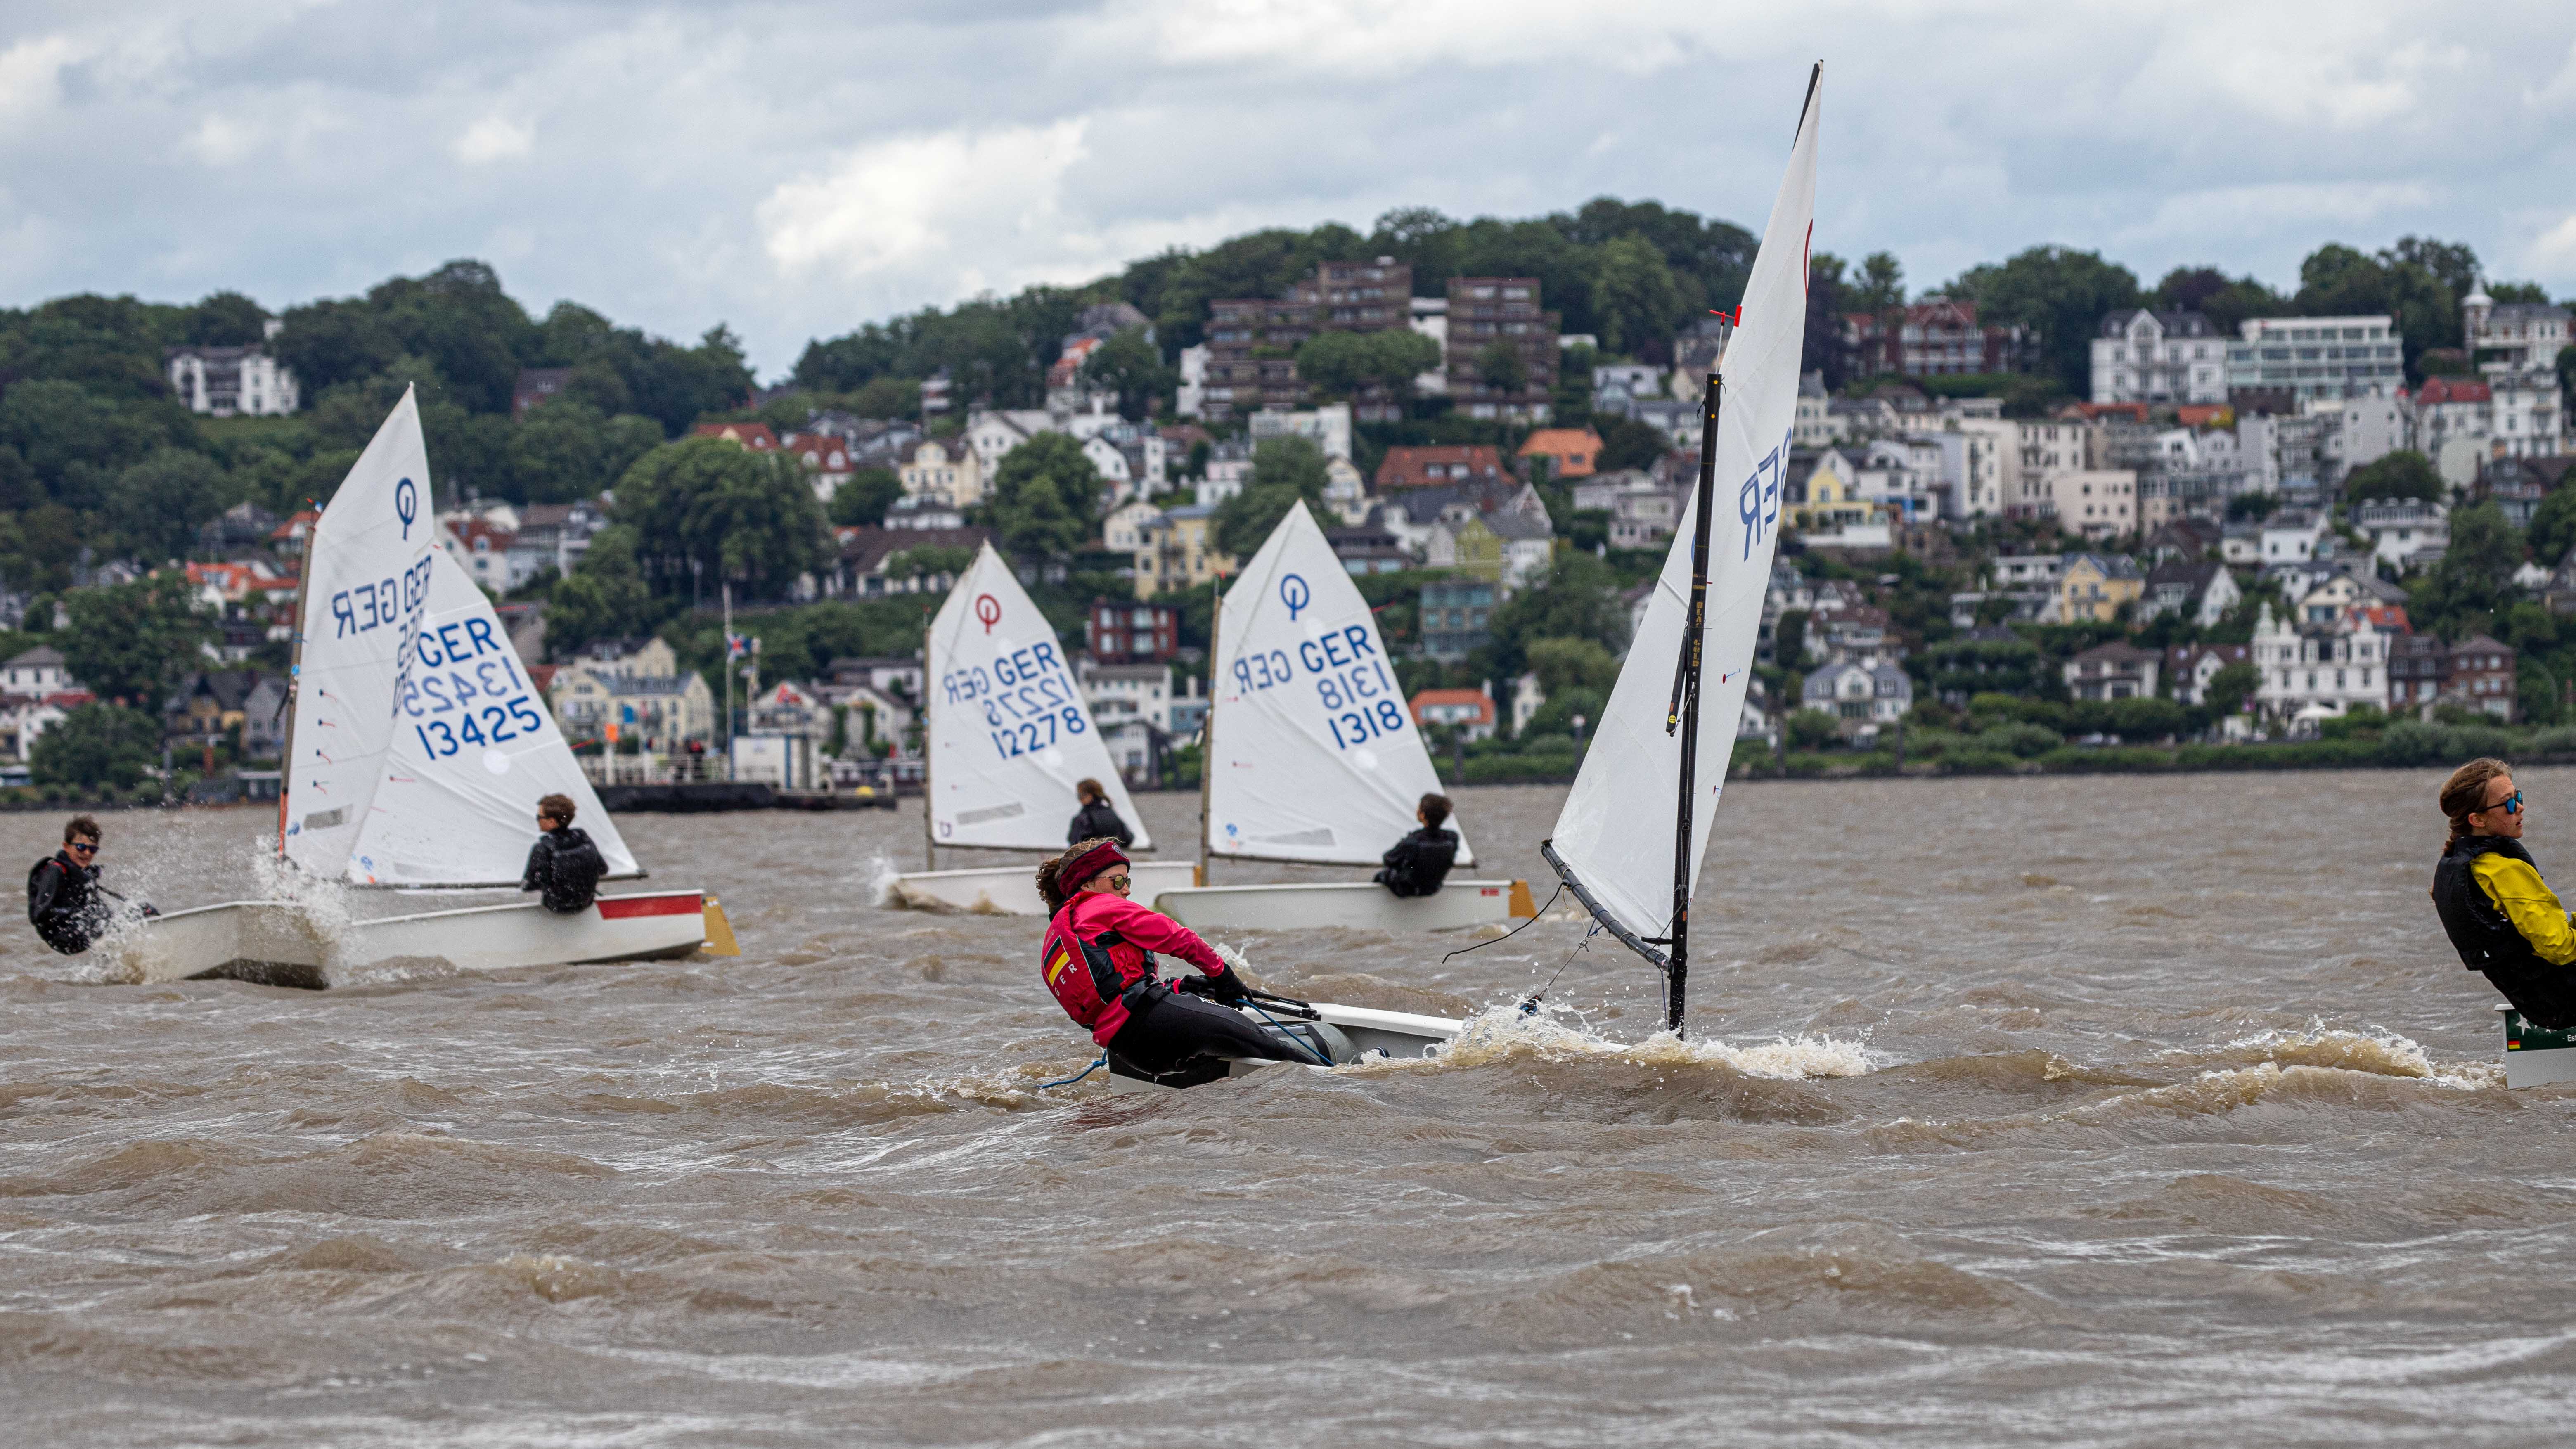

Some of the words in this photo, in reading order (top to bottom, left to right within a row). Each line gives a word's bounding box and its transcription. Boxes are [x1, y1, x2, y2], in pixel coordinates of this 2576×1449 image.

[404, 554, 431, 613] GER
[417, 618, 500, 667] GER
[995, 642, 1059, 685] GER
[1300, 625, 1376, 672] GER
[416, 696, 540, 760] 13425
[992, 707, 1085, 759] 12278
[1329, 700, 1404, 750] 1318
[1054, 964, 1077, 996] GER
